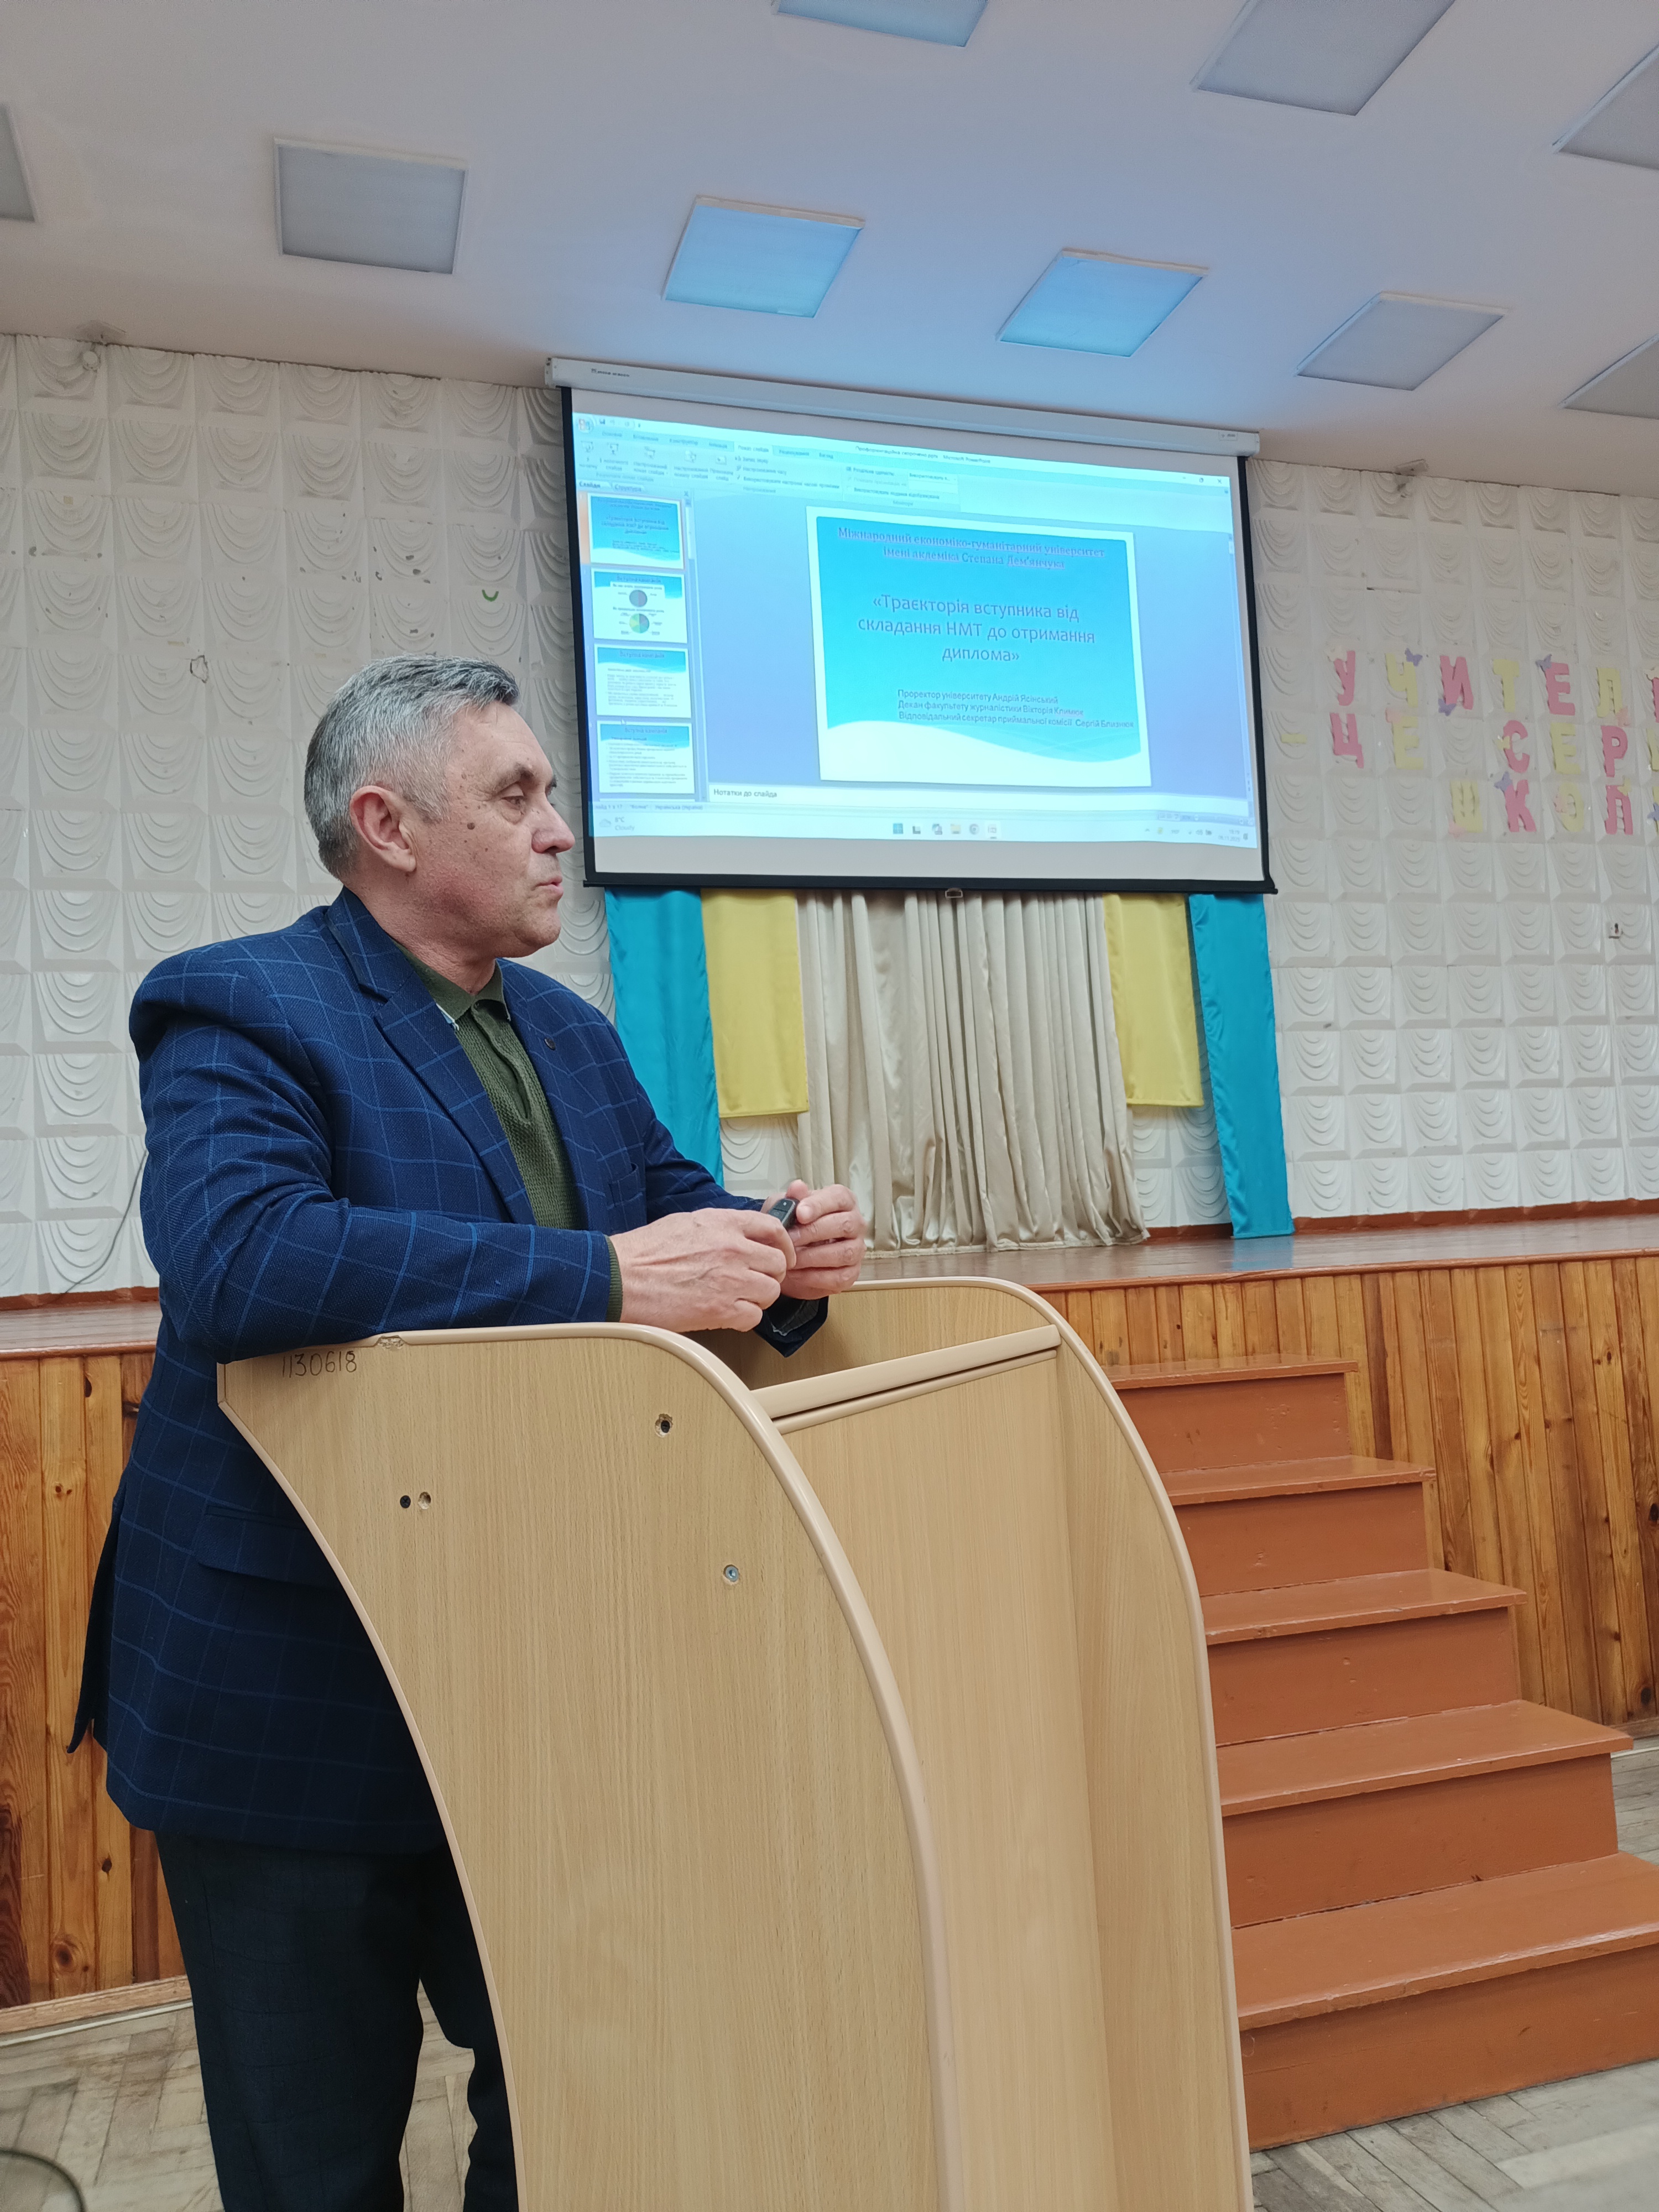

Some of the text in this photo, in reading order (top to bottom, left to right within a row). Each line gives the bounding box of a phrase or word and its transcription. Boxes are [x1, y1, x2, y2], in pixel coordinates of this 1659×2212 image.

[838, 527, 1104, 557] Міжнародний економіко-гуманітарний університет
[884, 546, 910, 557] імені
[962, 554, 1004, 565] Степана
[873, 594, 1079, 623] «Траєкторія вступника від
[858, 619, 1095, 644] складання НМТ до отримання
[942, 648, 1020, 662] диплома»
[898, 689, 1058, 704] Проректор університету Андрій Ясінський
[898, 700, 923, 709] Декан
[924, 701, 968, 711] факультету
[969, 704, 1022, 712] журналістики
[1023, 705, 1053, 715] Вікторія
[899, 711, 961, 721] Відповідальний
[962, 714, 995, 723] секретар
[998, 715, 1047, 724] приймальної
[1048, 718, 1072, 727] комісії
[1075, 718, 1100, 728] Сергій
[1329, 712, 1424, 770] ЦЕ
[1449, 778, 1659, 836] ШКОЛ
[281, 1350, 358, 1379] 1130618
